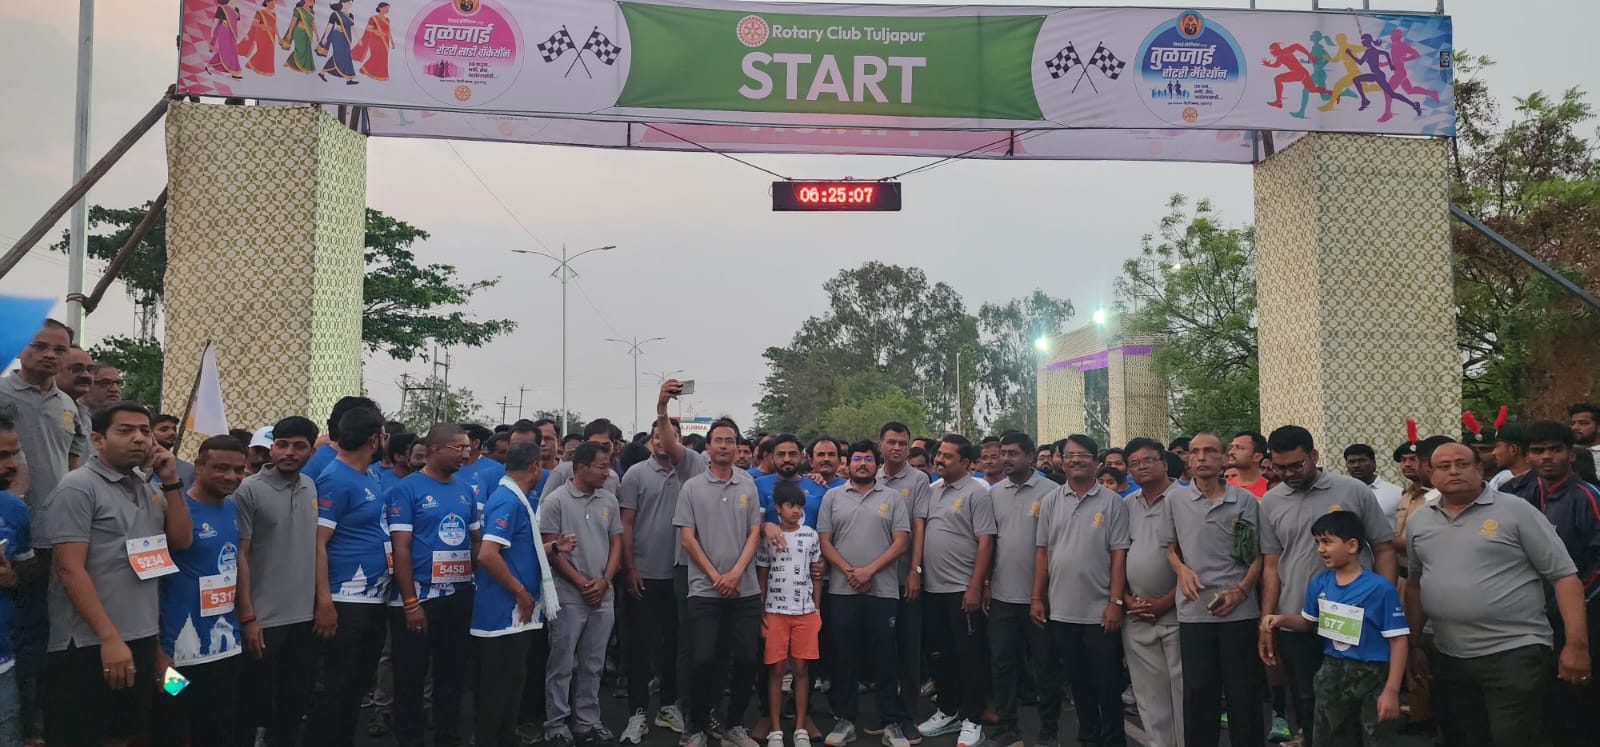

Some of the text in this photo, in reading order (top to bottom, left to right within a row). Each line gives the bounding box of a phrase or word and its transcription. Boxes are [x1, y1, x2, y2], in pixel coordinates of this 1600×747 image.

[424, 24, 494, 47] तुळजाई
[772, 25, 926, 45] Rotary Club Tuljapur
[1150, 45, 1217, 70] तुळजाई
[738, 51, 927, 104] START
[1162, 66, 1189, 79] रोटरी
[800, 187, 873, 203] 06:25:07
[137, 554, 165, 569] 5234
[439, 564, 465, 574] 5458
